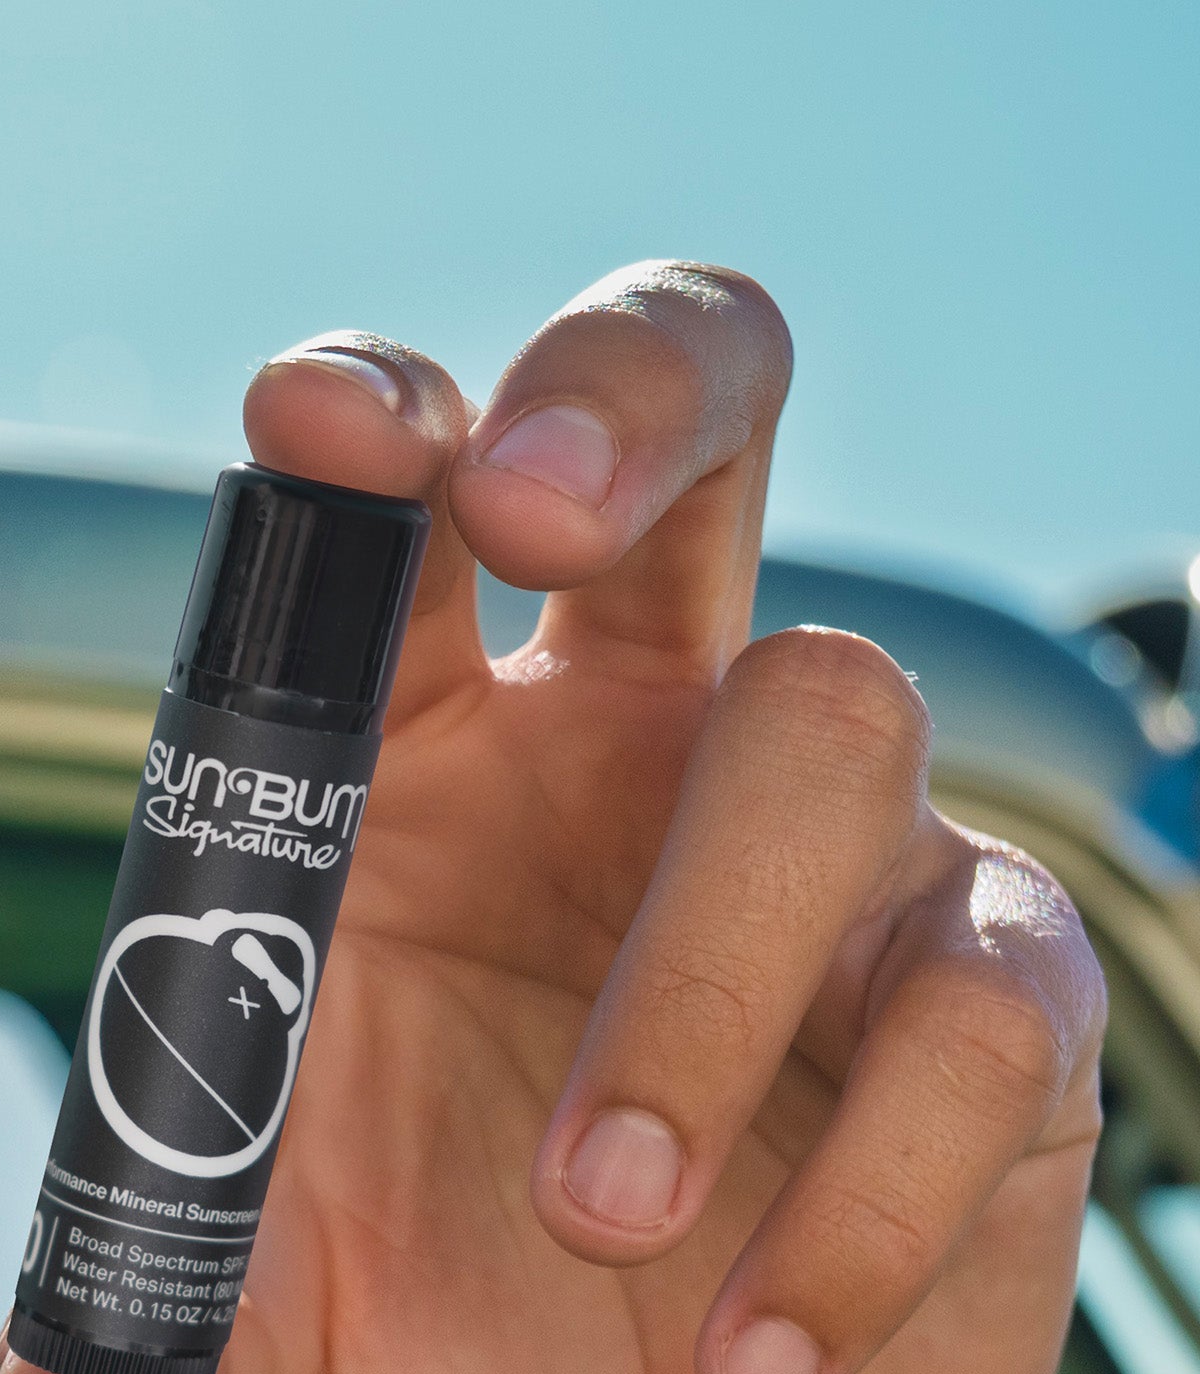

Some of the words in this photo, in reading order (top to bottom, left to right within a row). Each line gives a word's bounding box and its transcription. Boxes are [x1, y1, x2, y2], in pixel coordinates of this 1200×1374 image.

[143, 795, 341, 870] Signature
[109, 1186, 184, 1219] Mineral
[69, 1226, 123, 1259] Broad
[127, 1245, 219, 1275] Spectrum
[63, 1251, 117, 1282] Water
[121, 1269, 211, 1299] Resistant
[56, 1276, 89, 1302] Net
[93, 1288, 123, 1312] Wt.
[129, 1298, 172, 1321] 0.15
[176, 1305, 202, 1324] OZ
